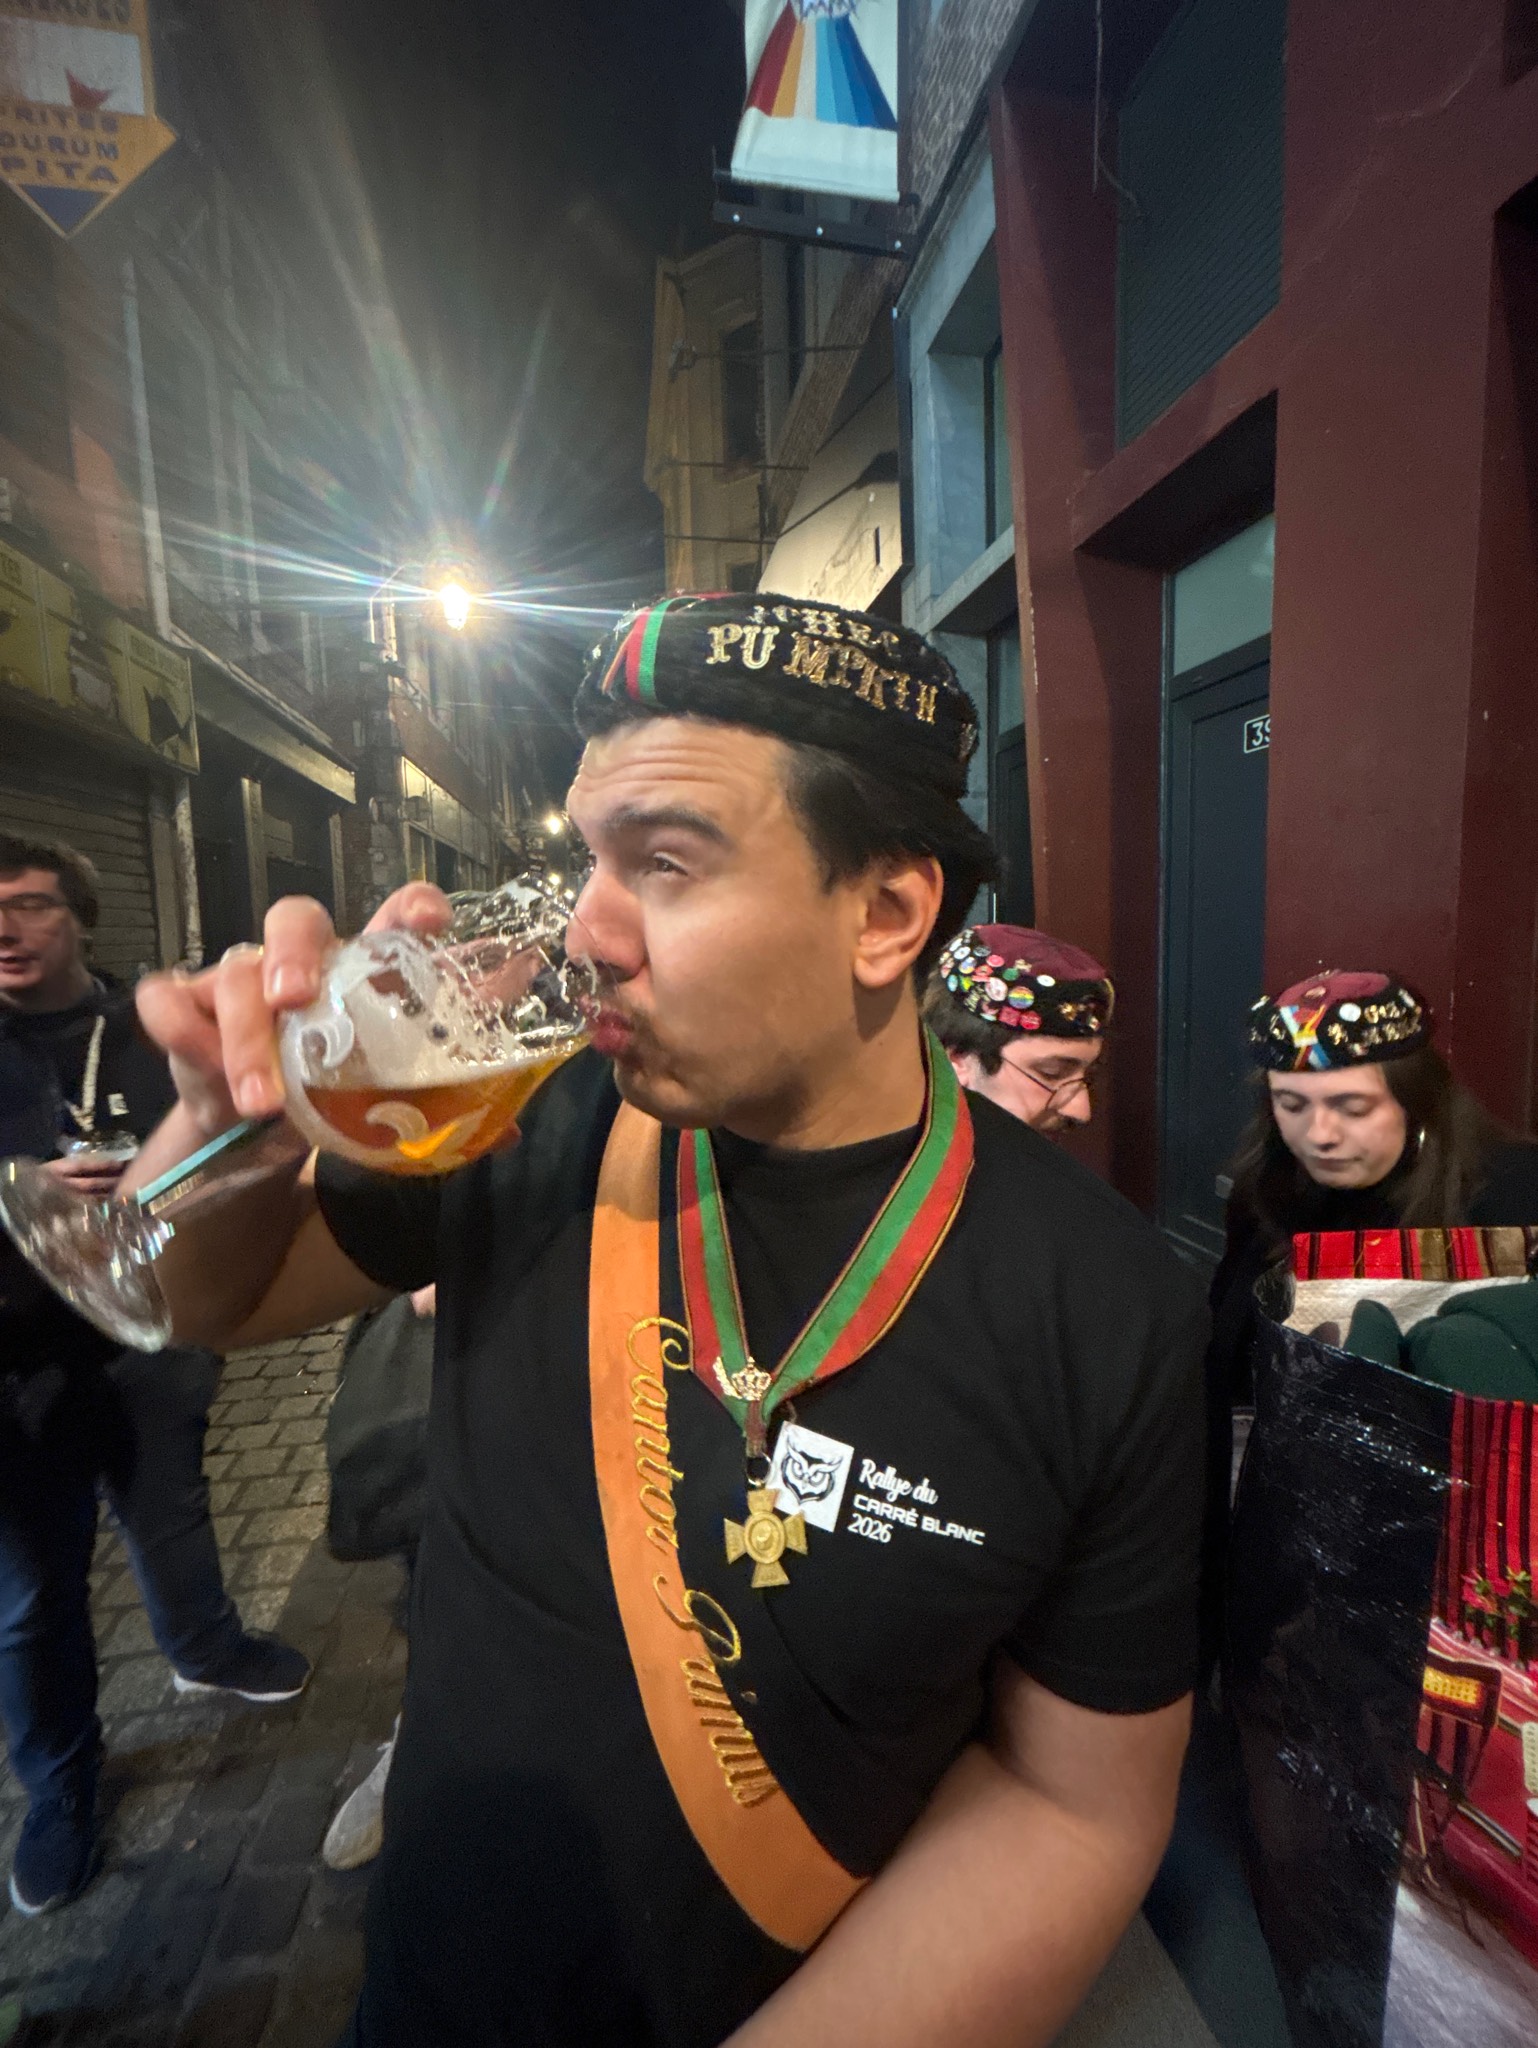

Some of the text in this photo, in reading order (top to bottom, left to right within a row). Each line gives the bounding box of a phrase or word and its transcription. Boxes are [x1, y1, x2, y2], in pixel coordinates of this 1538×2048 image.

[1, 155, 118, 184] PITA
[627, 1317, 691, 1556] Cantor
[859, 1458, 939, 1505] Rallye du
[847, 1512, 894, 1544] 2026
[853, 1493, 986, 1546] CARRÉ BLANC
